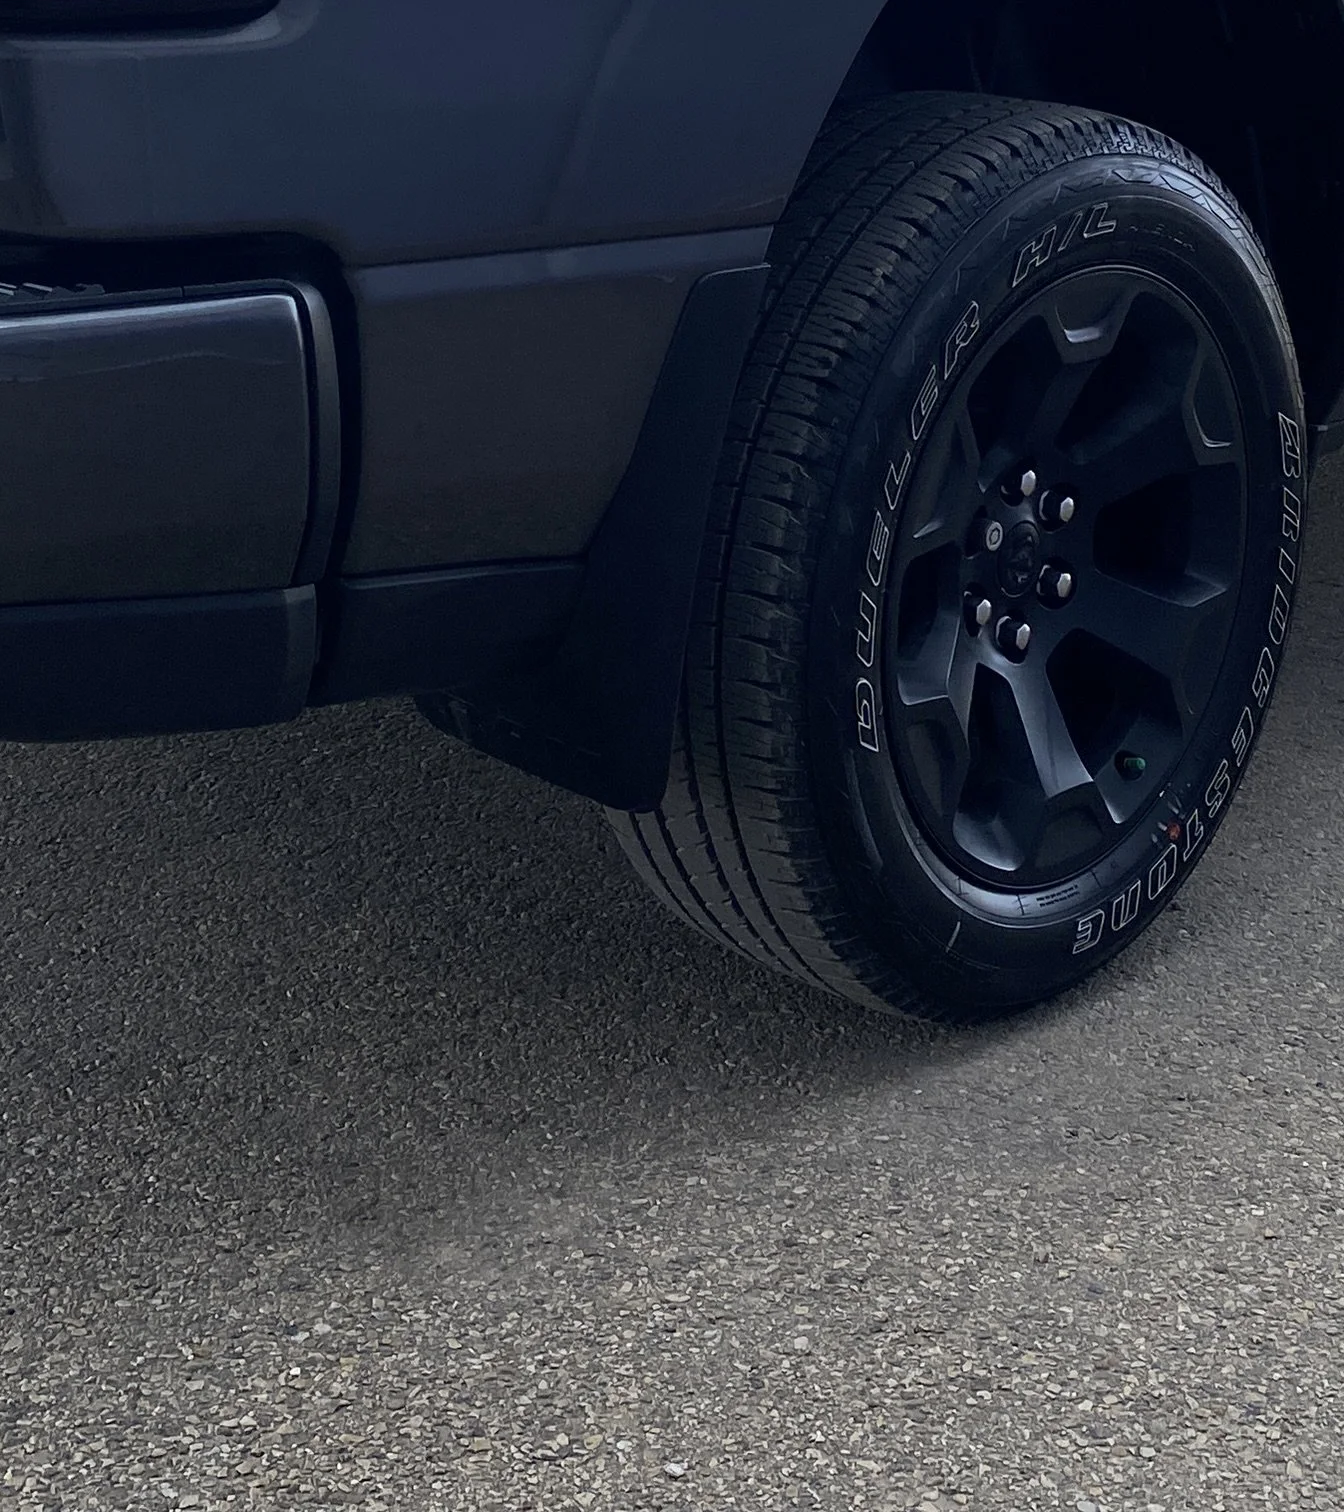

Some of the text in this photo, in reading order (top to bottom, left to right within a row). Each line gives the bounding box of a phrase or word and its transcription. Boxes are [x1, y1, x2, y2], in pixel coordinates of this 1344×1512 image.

[855, 201, 1117, 753] DUELER H/L
[1071, 411, 1302, 956] BRIDGESTONE
